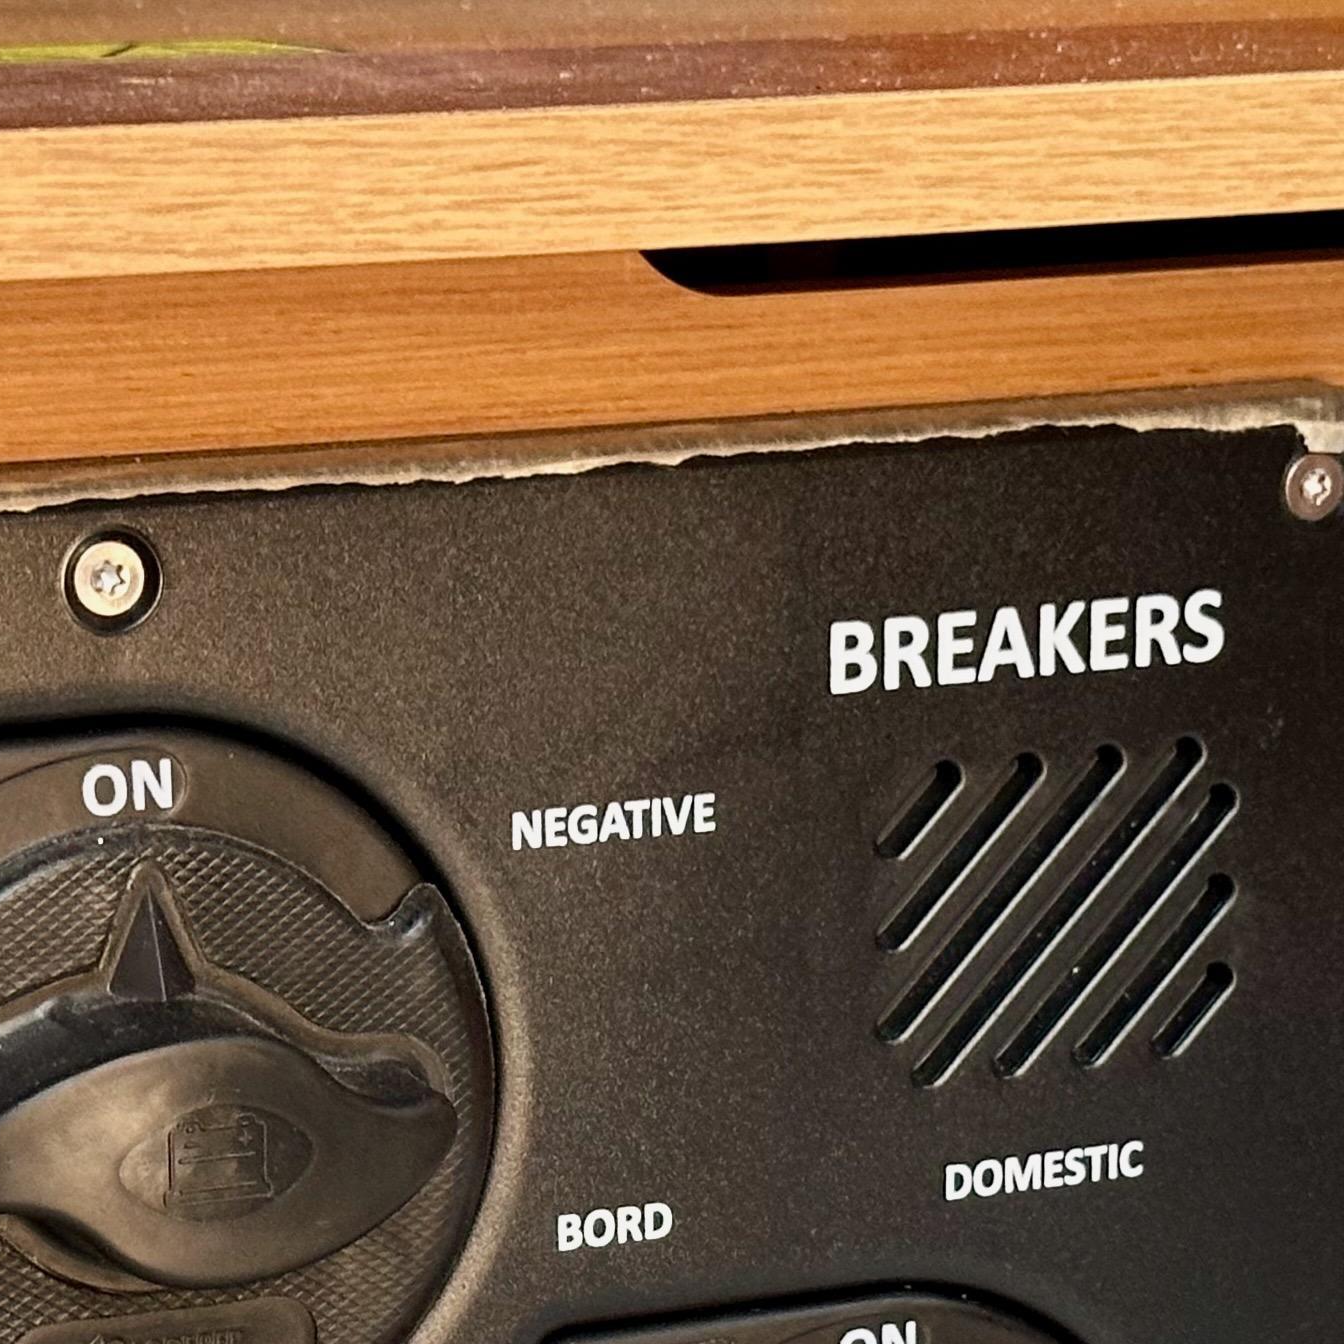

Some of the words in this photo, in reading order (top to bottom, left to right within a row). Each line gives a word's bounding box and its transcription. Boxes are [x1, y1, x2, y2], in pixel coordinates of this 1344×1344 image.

[829, 589, 1224, 695] BREAKERS
[82, 758, 173, 817] ON
[512, 793, 716, 851] NEGATIVE
[945, 1140, 1144, 1201] DOMESTIC
[557, 1202, 673, 1252] BORD
